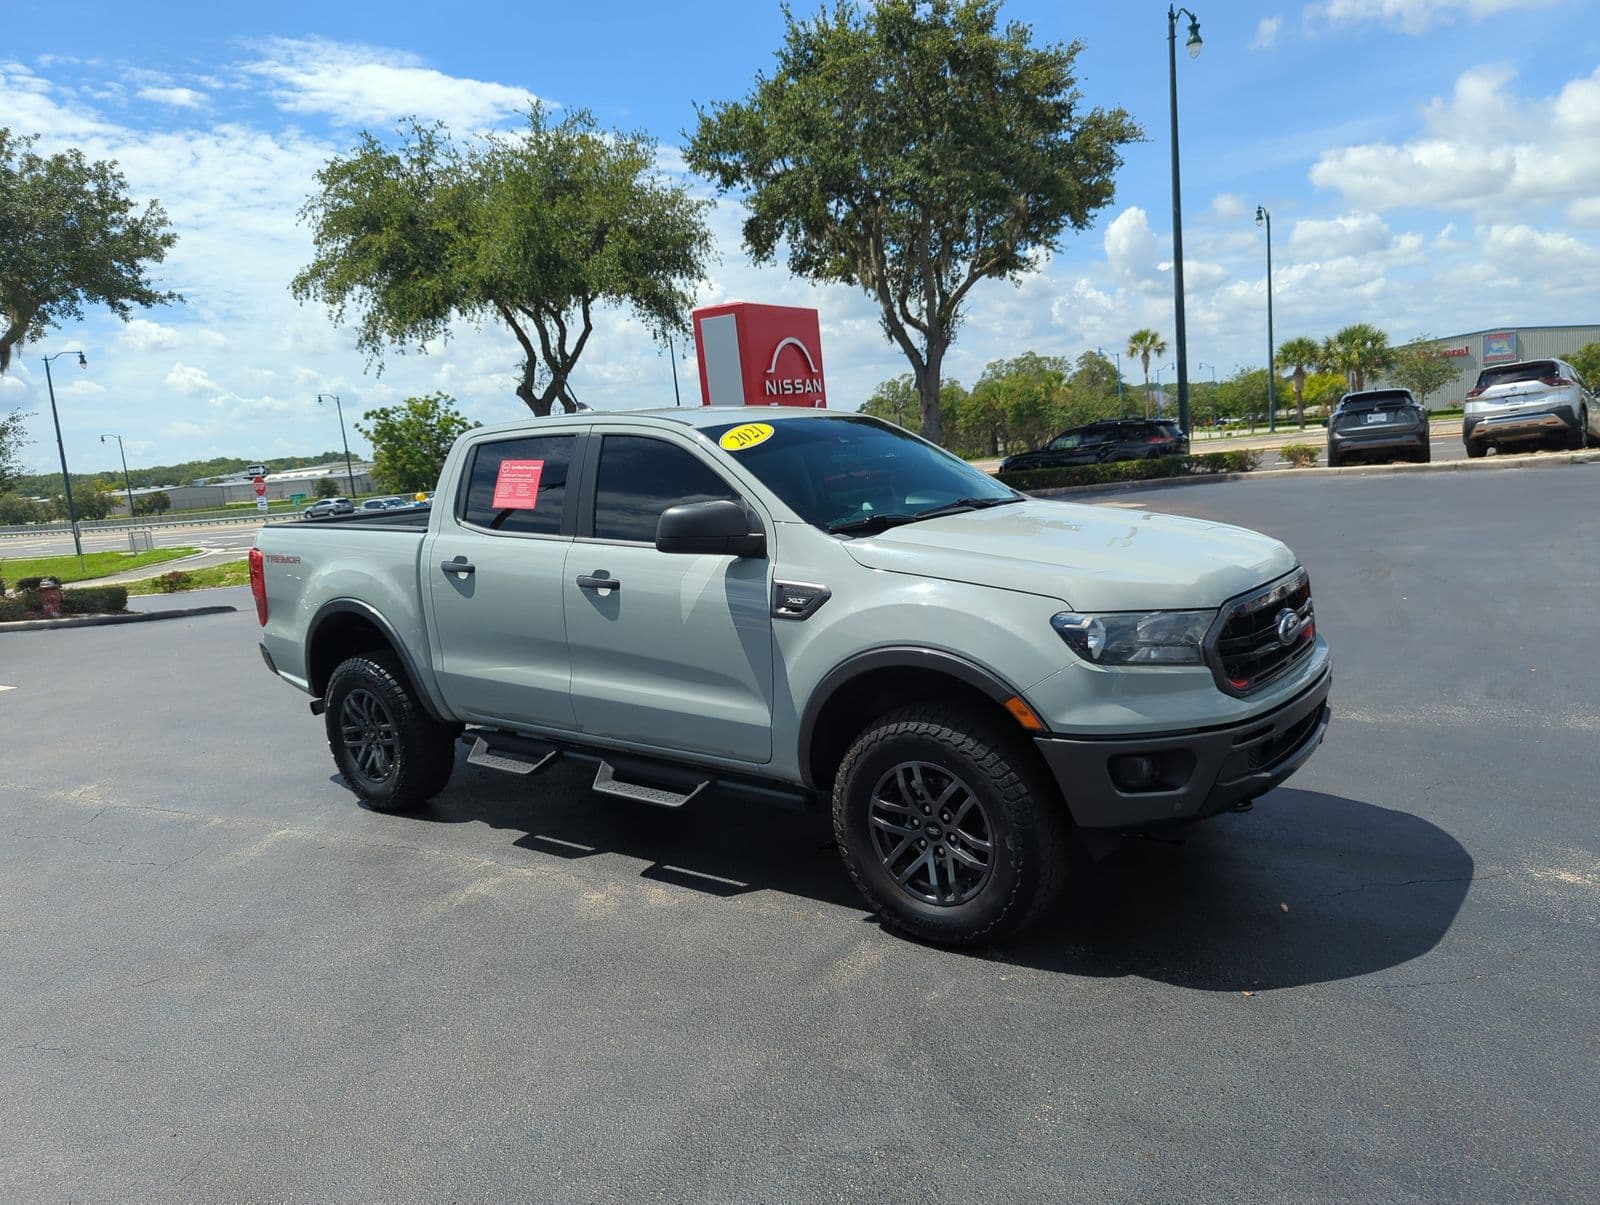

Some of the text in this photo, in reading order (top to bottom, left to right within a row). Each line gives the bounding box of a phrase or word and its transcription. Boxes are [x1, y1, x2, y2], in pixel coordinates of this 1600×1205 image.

[765, 378, 822, 396] NISSAN
[730, 425, 765, 447] 2021
[265, 554, 301, 565] TREMOR
